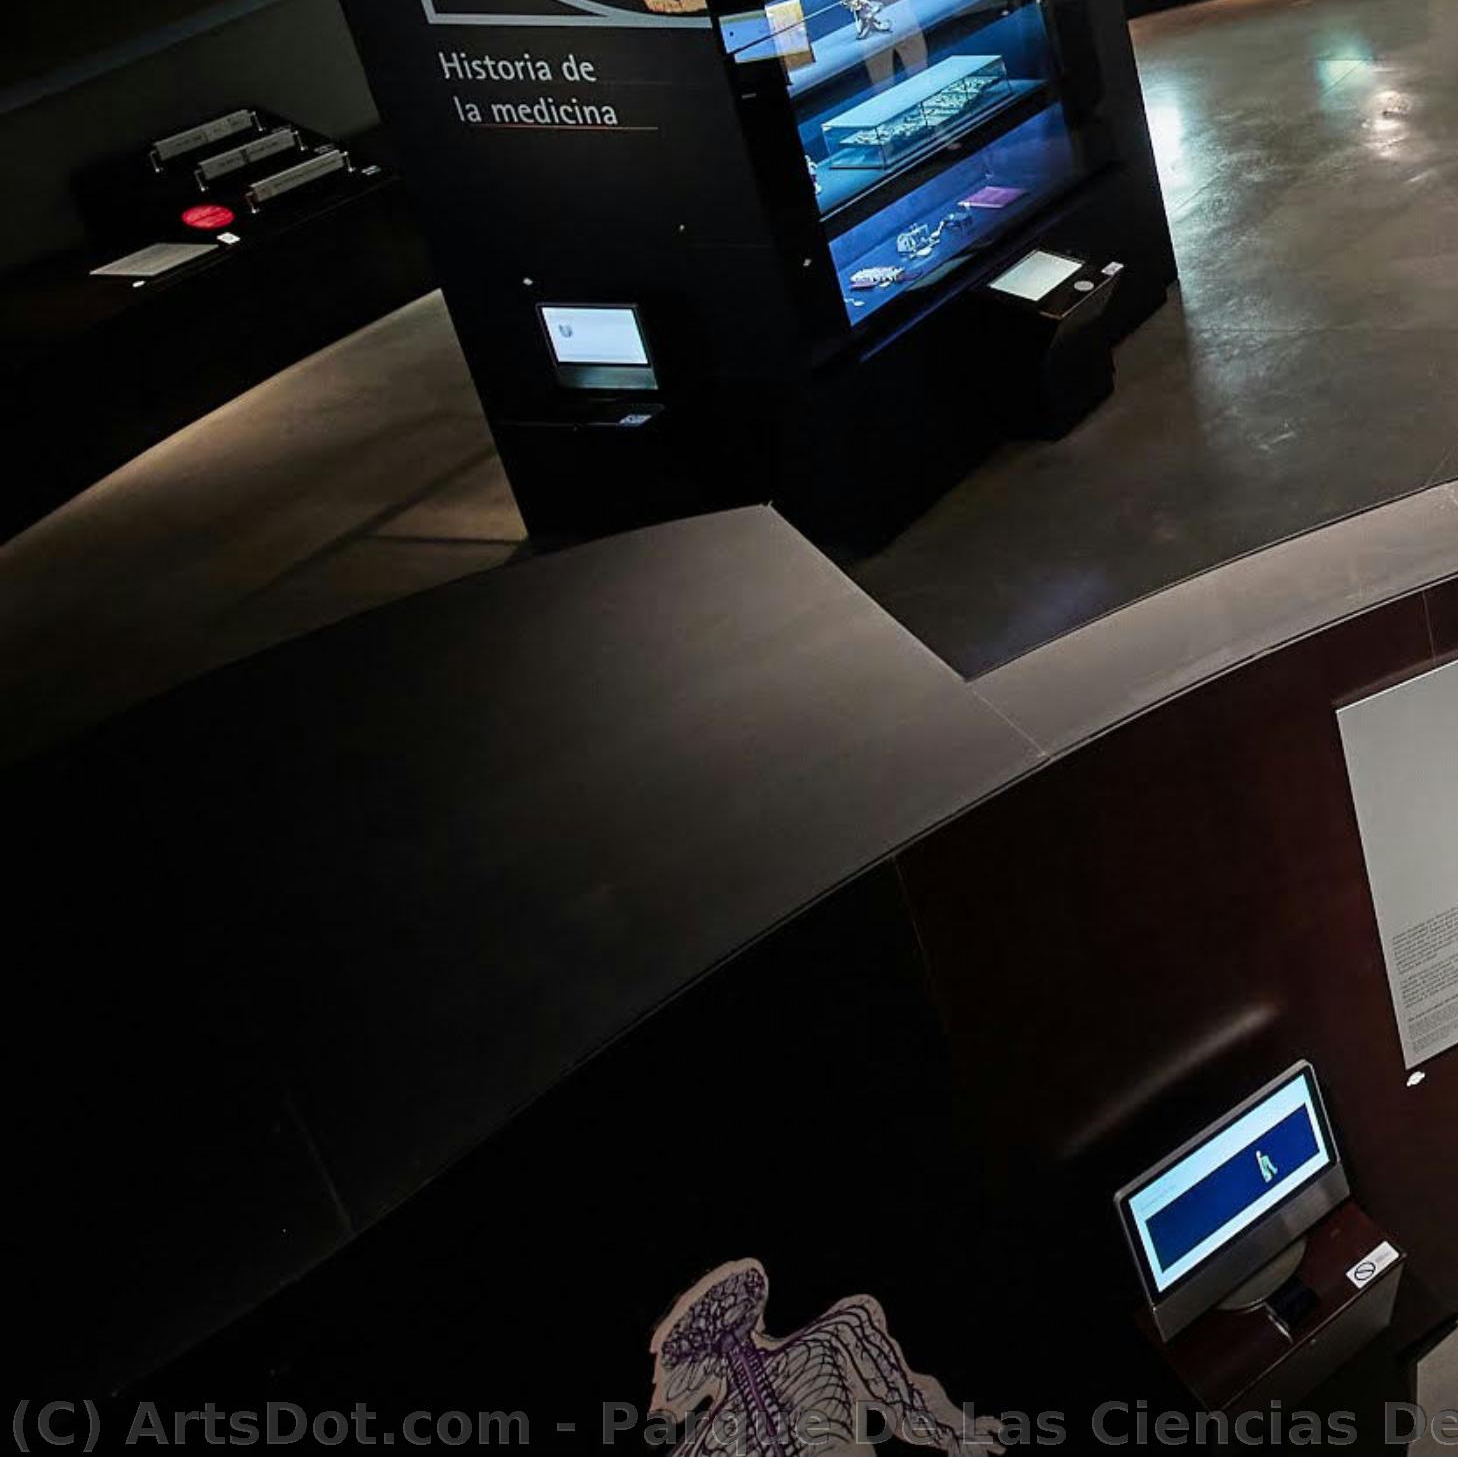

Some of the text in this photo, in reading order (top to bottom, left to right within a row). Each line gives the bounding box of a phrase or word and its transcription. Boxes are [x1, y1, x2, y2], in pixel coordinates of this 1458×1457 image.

[438, 52, 598, 83] Historia de
[453, 95, 618, 125] la medicina
